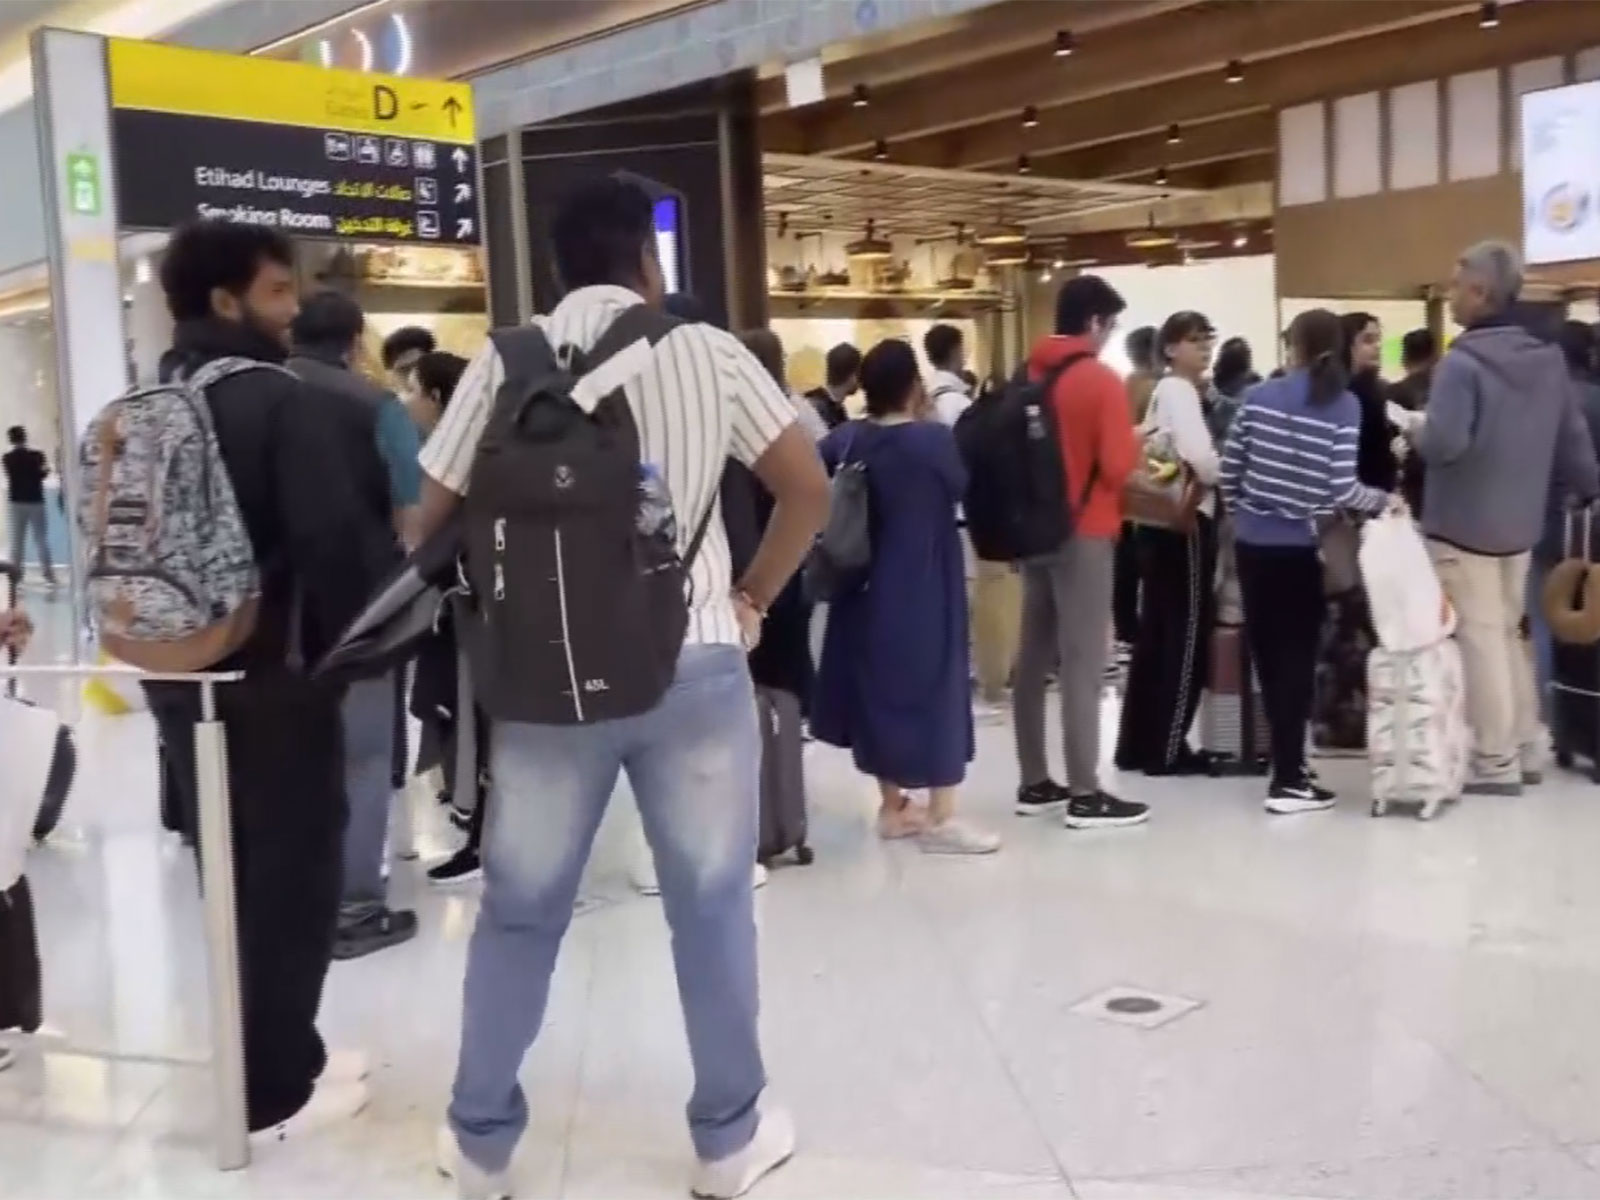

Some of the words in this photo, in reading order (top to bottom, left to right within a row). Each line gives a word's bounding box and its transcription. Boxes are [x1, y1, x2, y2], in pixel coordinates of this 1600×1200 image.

[373, 84, 399, 120] D
[194, 166, 255, 188] Etihad
[258, 170, 331, 198] Lounges
[280, 208, 332, 230] Room
